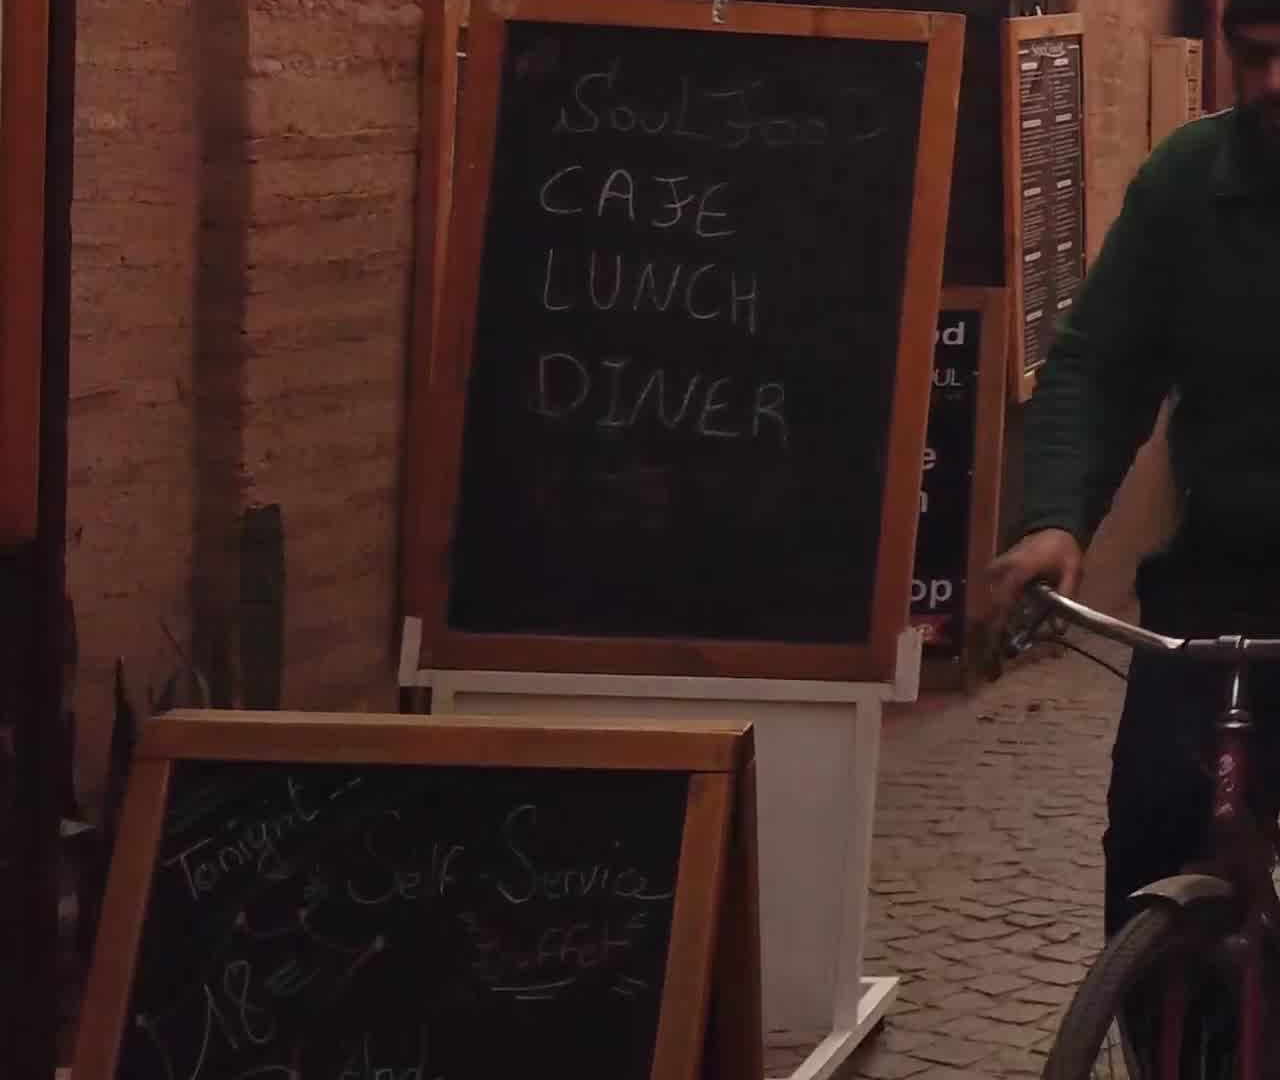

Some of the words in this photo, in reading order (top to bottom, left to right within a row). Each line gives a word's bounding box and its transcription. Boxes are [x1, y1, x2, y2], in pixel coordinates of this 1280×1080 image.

[543, 247, 760, 335] LUNCH
[530, 352, 789, 447] DINER
[345, 808, 465, 905] Self
